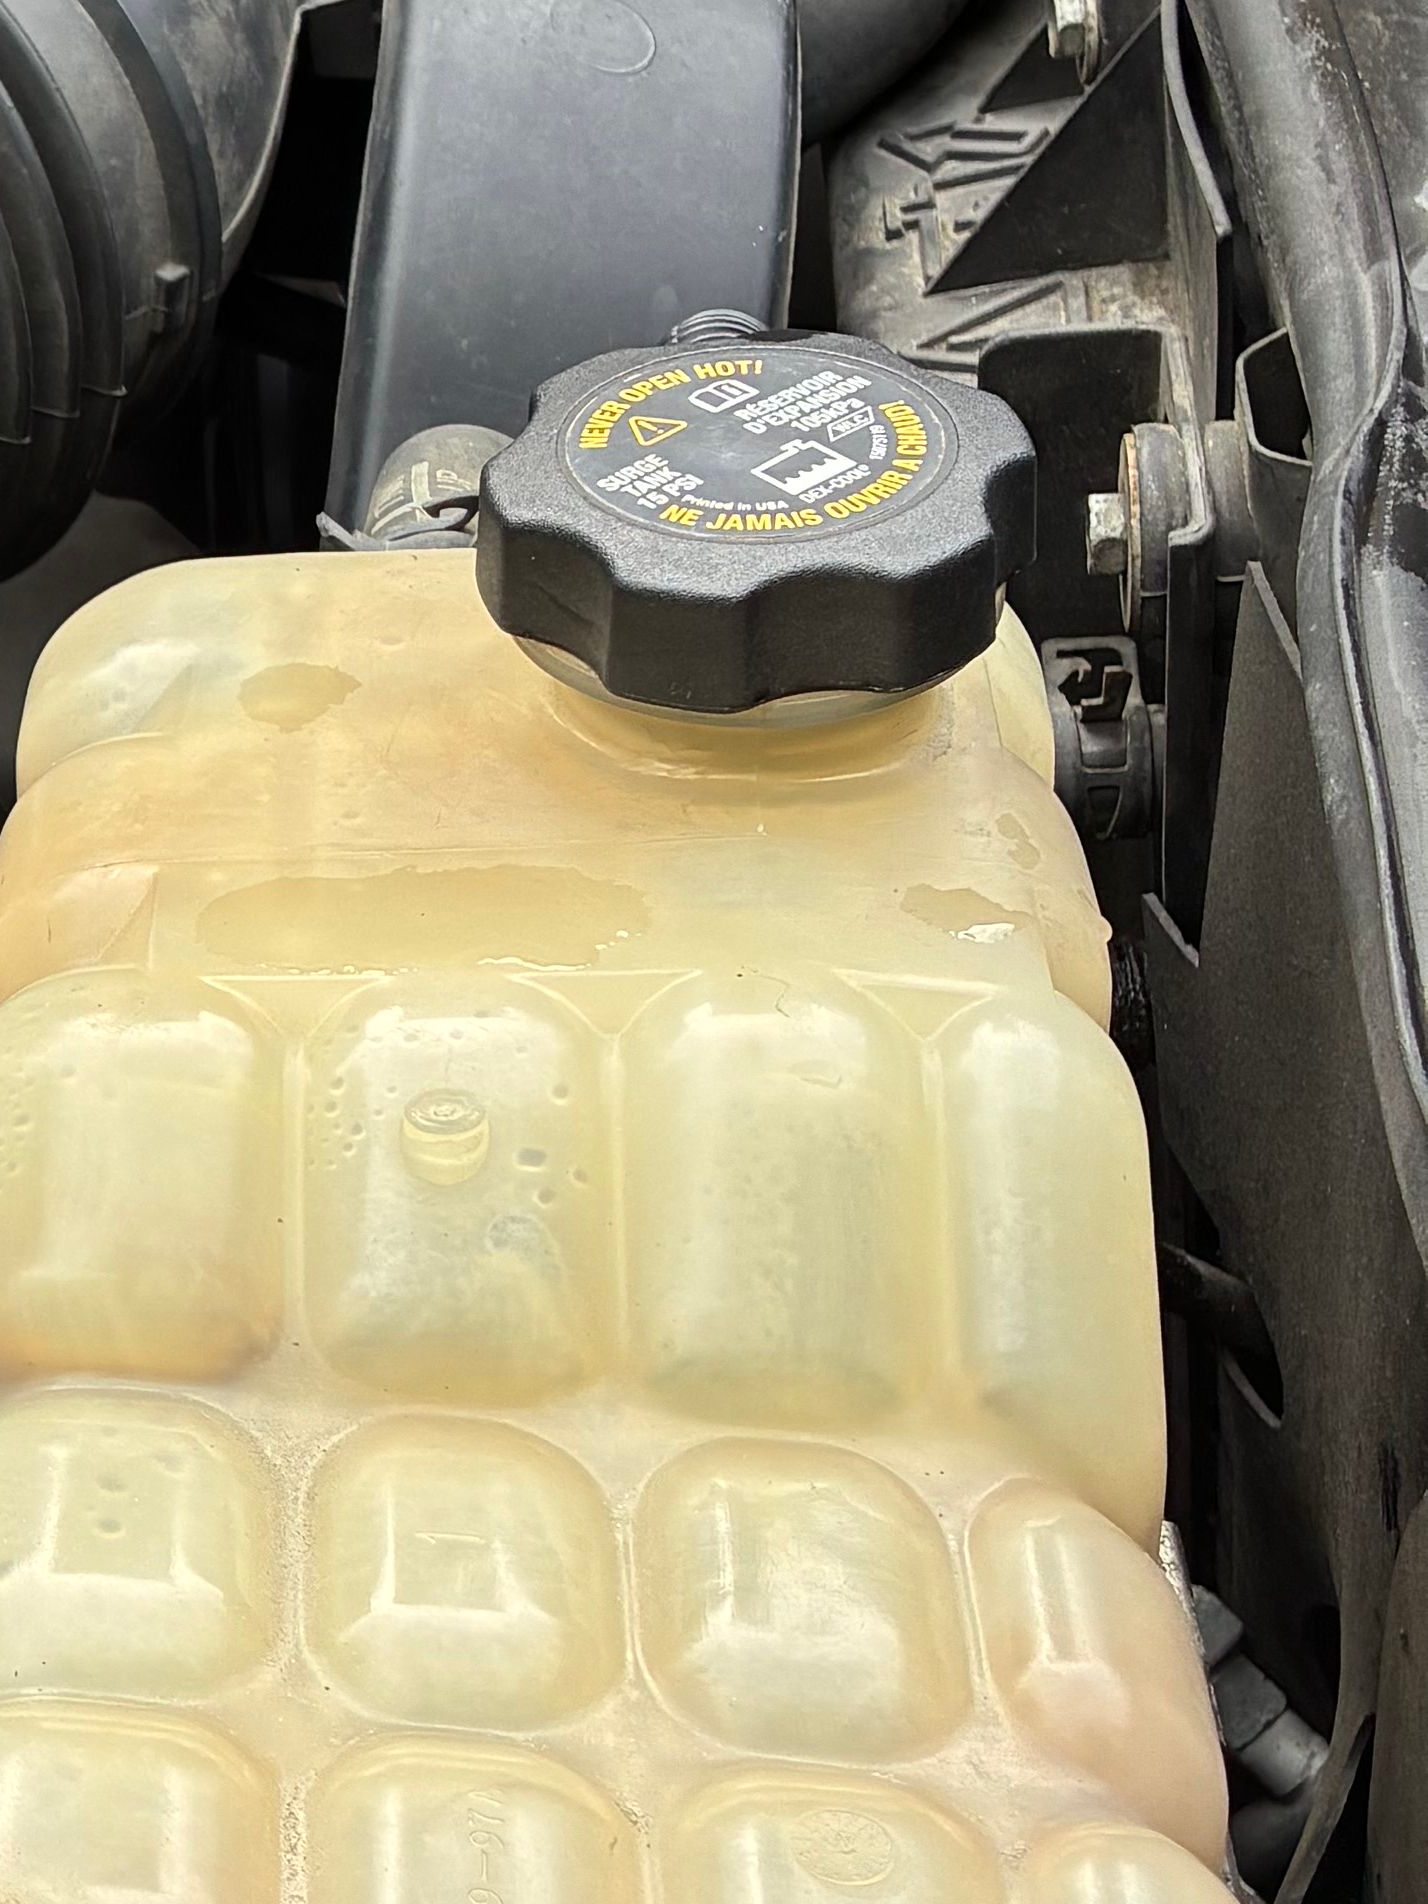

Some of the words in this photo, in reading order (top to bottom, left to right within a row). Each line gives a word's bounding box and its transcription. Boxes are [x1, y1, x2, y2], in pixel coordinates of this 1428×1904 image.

[579, 399, 625, 450] NEVER
[617, 369, 689, 403] OPEN
[694, 359, 763, 380] HOT!
[735, 370, 844, 422] RÉSERVOIR
[743, 375, 874, 435] D'EXPANSION
[792, 397, 865, 432] 105kPa
[596, 454, 669, 493] SURGE
[621, 467, 682, 498] TANK
[659, 503, 705, 527] NE
[705, 507, 824, 531] JAMAIS
[824, 470, 914, 519] OUVRIR
[878, 399, 928, 456] CHAUD!
[637, 491, 670, 510] 15
[662, 472, 705, 497] PSI
[681, 494, 734, 511] Printed
[737, 500, 752, 511] in
[755, 500, 790, 511] USA
